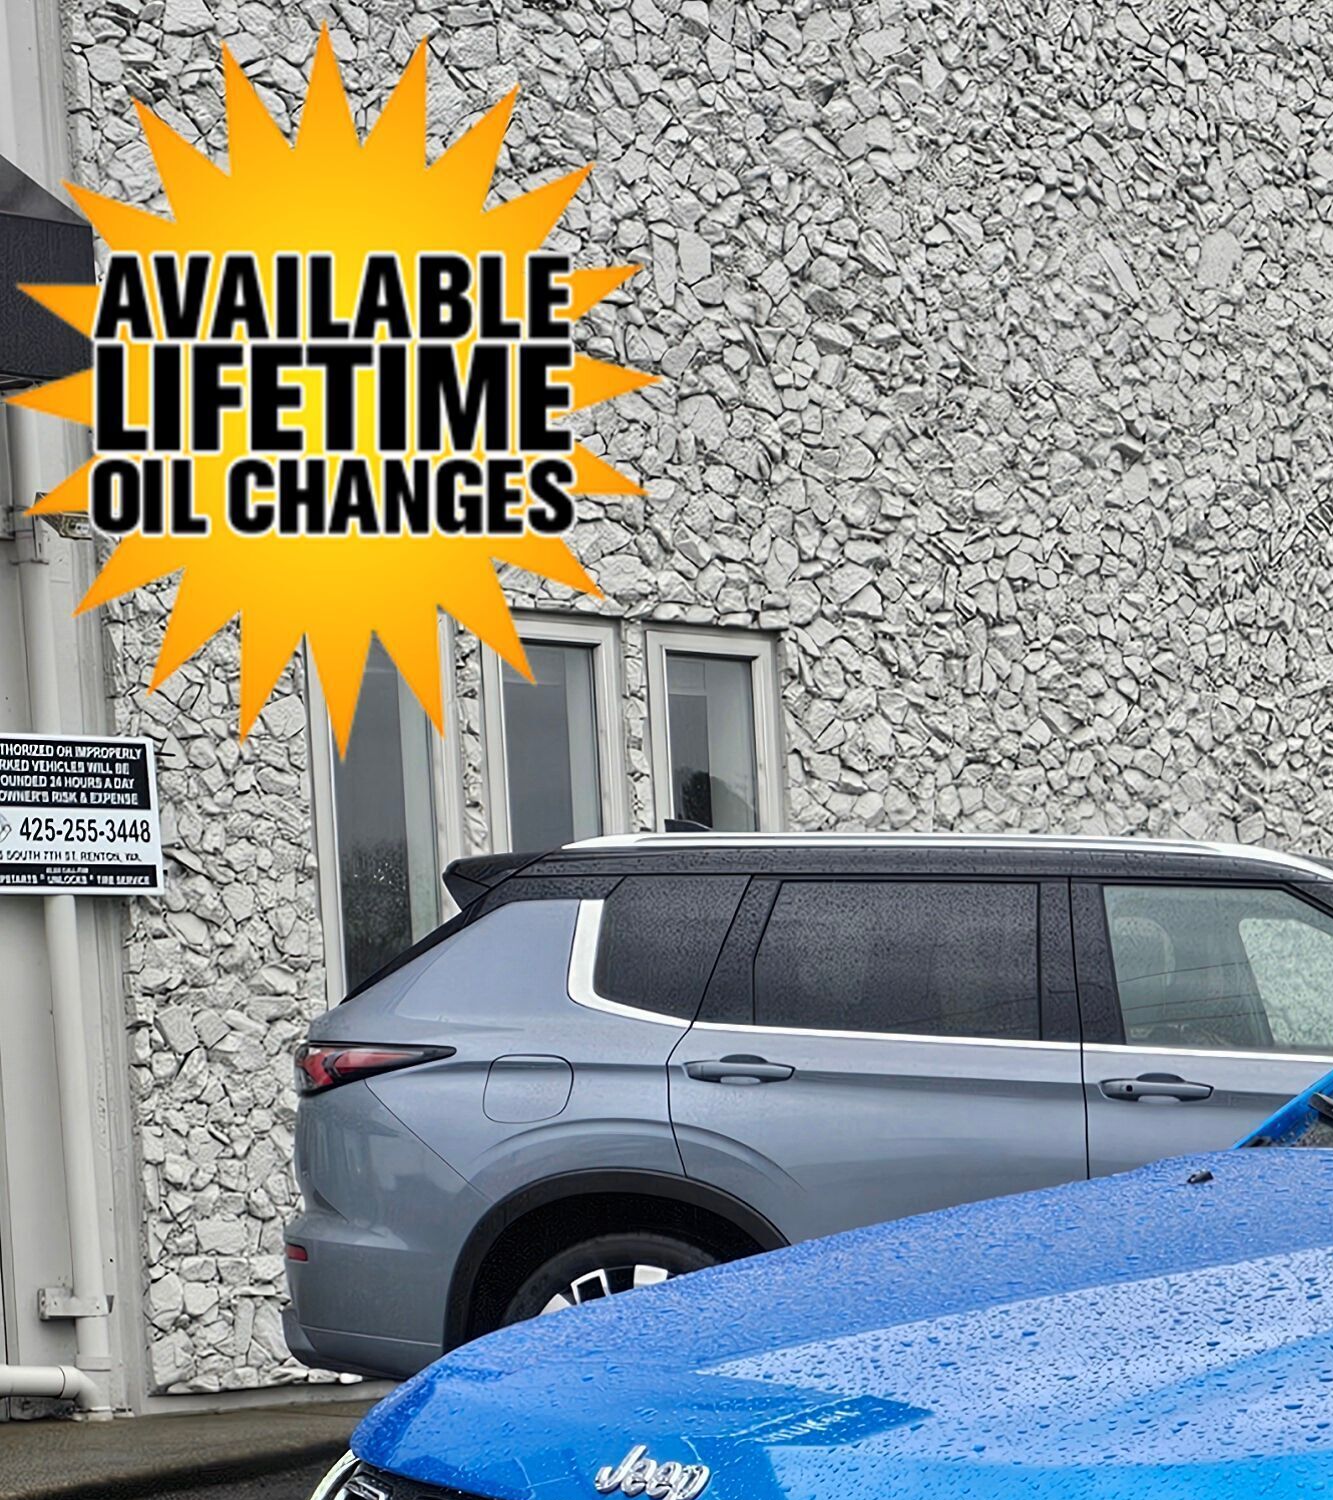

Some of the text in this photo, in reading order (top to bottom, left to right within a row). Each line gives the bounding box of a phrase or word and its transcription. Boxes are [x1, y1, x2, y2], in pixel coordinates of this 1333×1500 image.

[32, 760, 85, 773] VEHICLES
[87, 762, 113, 775] WILL
[64, 776, 102, 789] HOURS
[104, 777, 112, 789] A
[114, 777, 135, 790] DAY
[52, 791, 77, 803] RISK
[90, 792, 139, 806] EXPENSE
[19, 817, 151, 843] 425-255-3448
